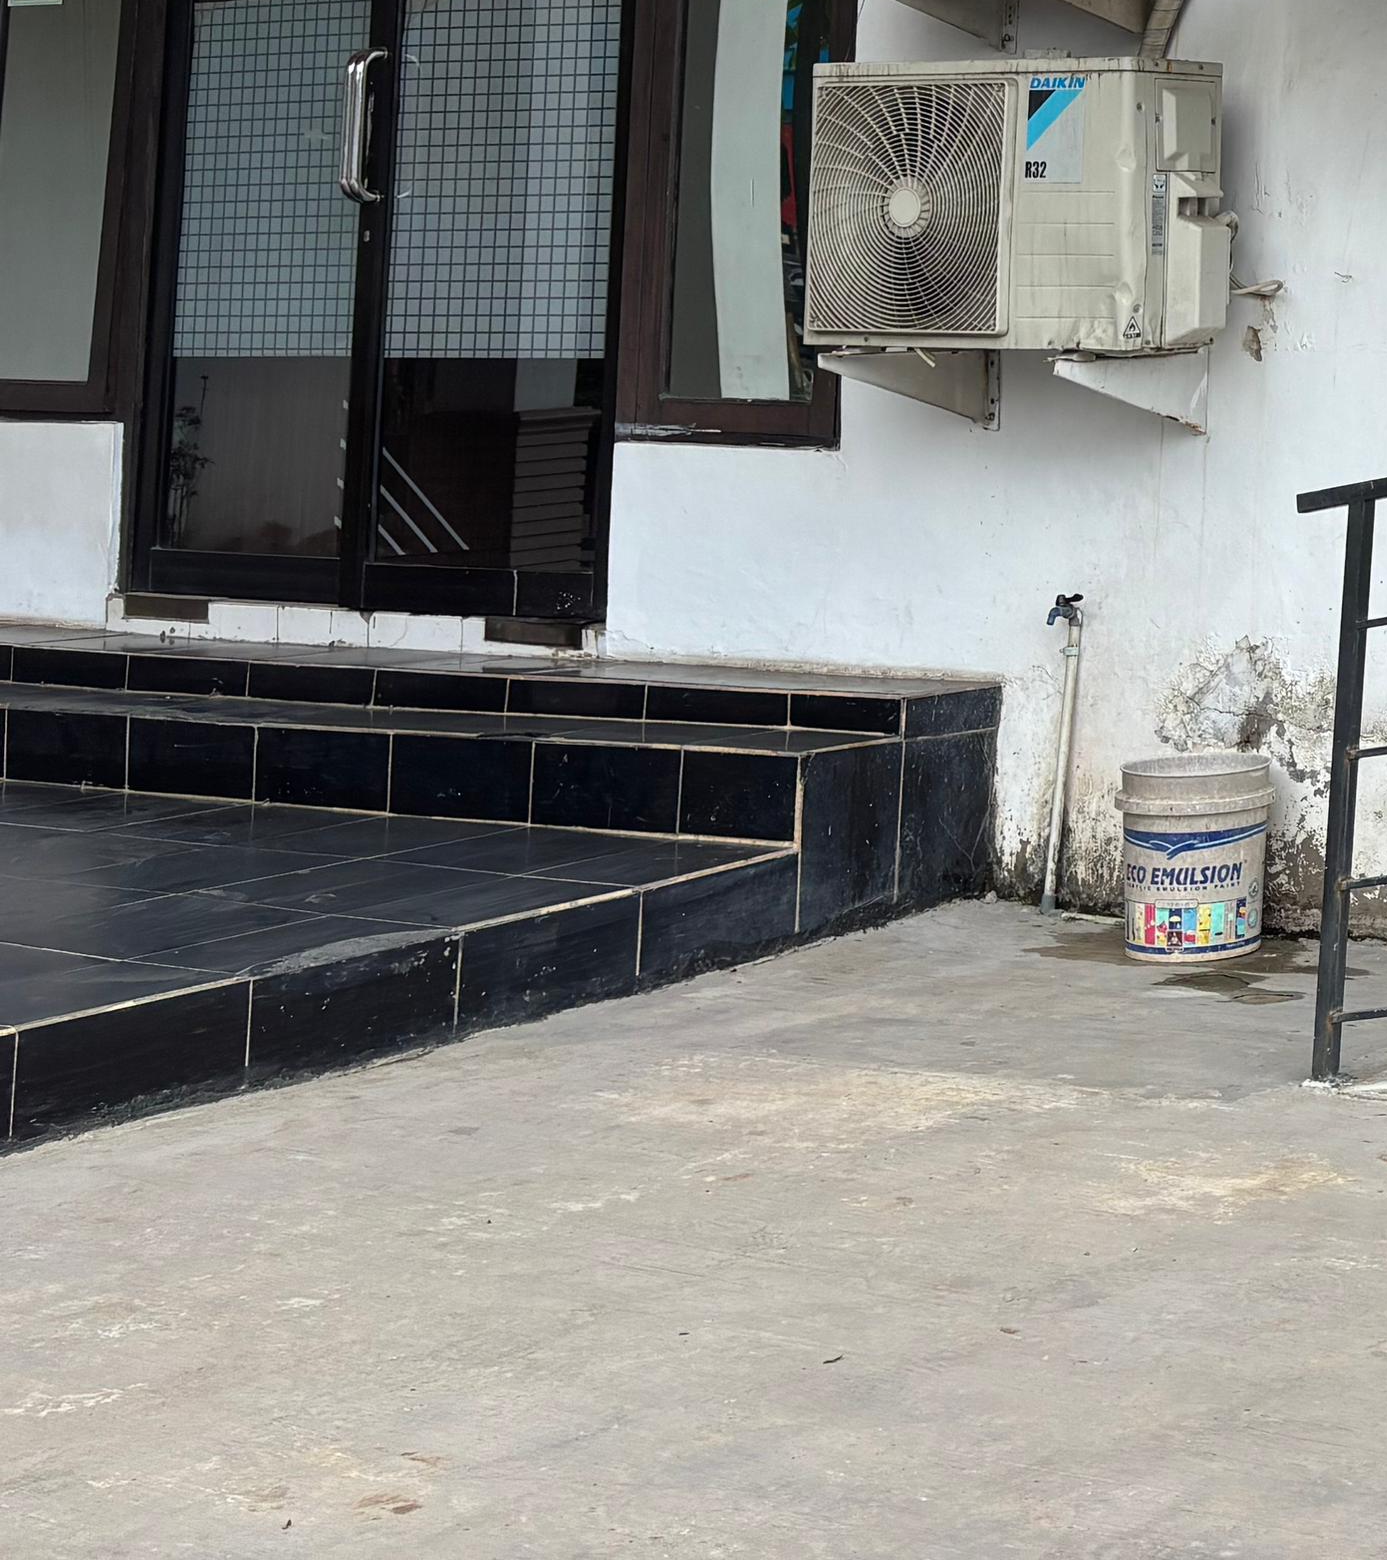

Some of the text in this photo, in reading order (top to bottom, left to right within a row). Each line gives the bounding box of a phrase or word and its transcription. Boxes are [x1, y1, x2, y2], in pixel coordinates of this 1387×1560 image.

[1030, 76, 1086, 89] DAIKIN
[1025, 160, 1047, 179] R32
[1151, 862, 1243, 886] EMULSION
